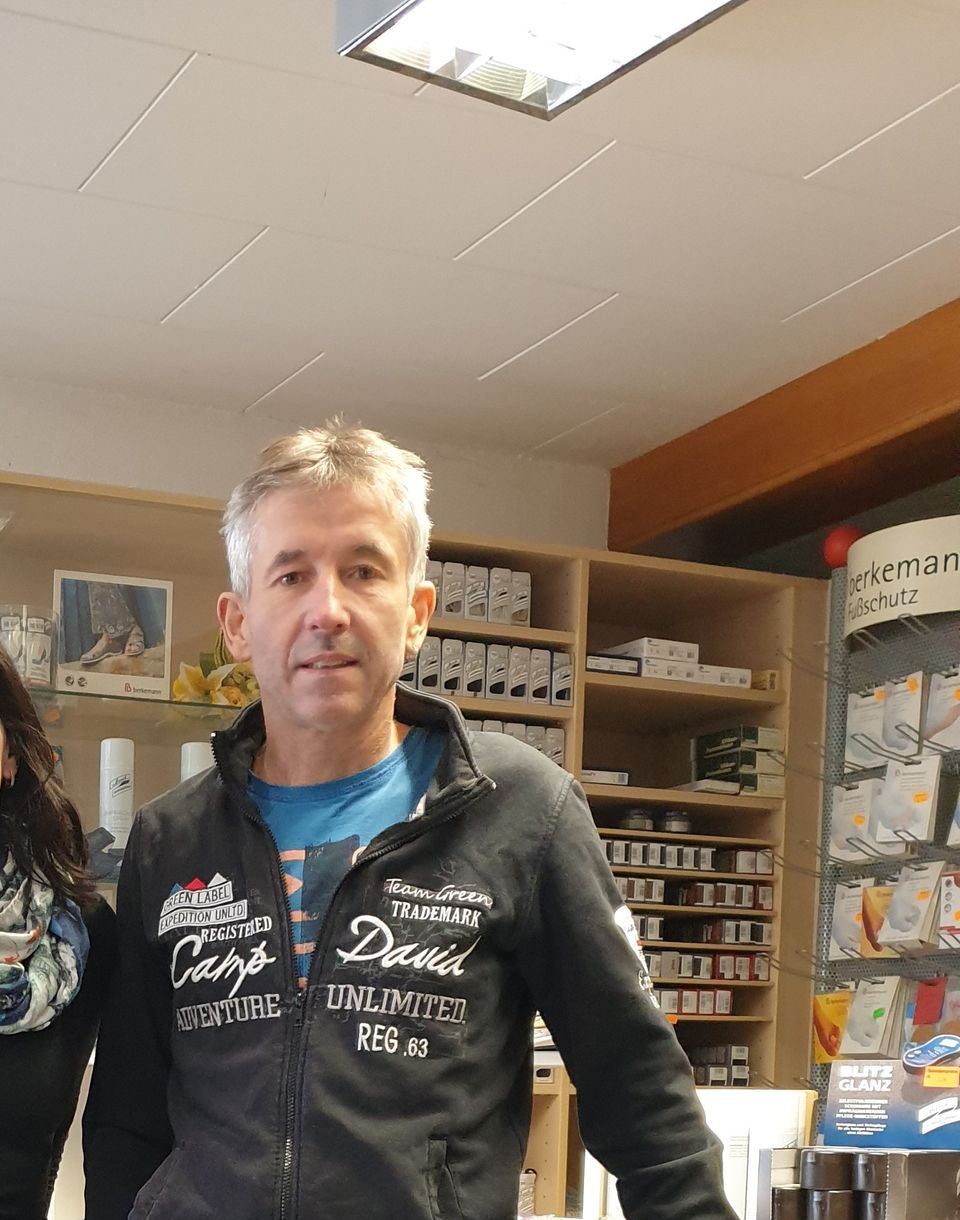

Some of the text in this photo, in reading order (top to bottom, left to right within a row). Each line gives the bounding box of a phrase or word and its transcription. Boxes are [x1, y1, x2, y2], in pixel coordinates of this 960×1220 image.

[164, 885, 230, 911] GREEN LABEL
[386, 878, 494, 908] Team Green
[160, 909, 212, 930] EXPEDITION
[392, 900, 482, 928] TRADEMARK
[336, 915, 482, 977] David
[357, 1023, 399, 1053] REG
[839, 1065, 893, 1078] BLITZ
[839, 1079, 891, 1092] GLANZ
